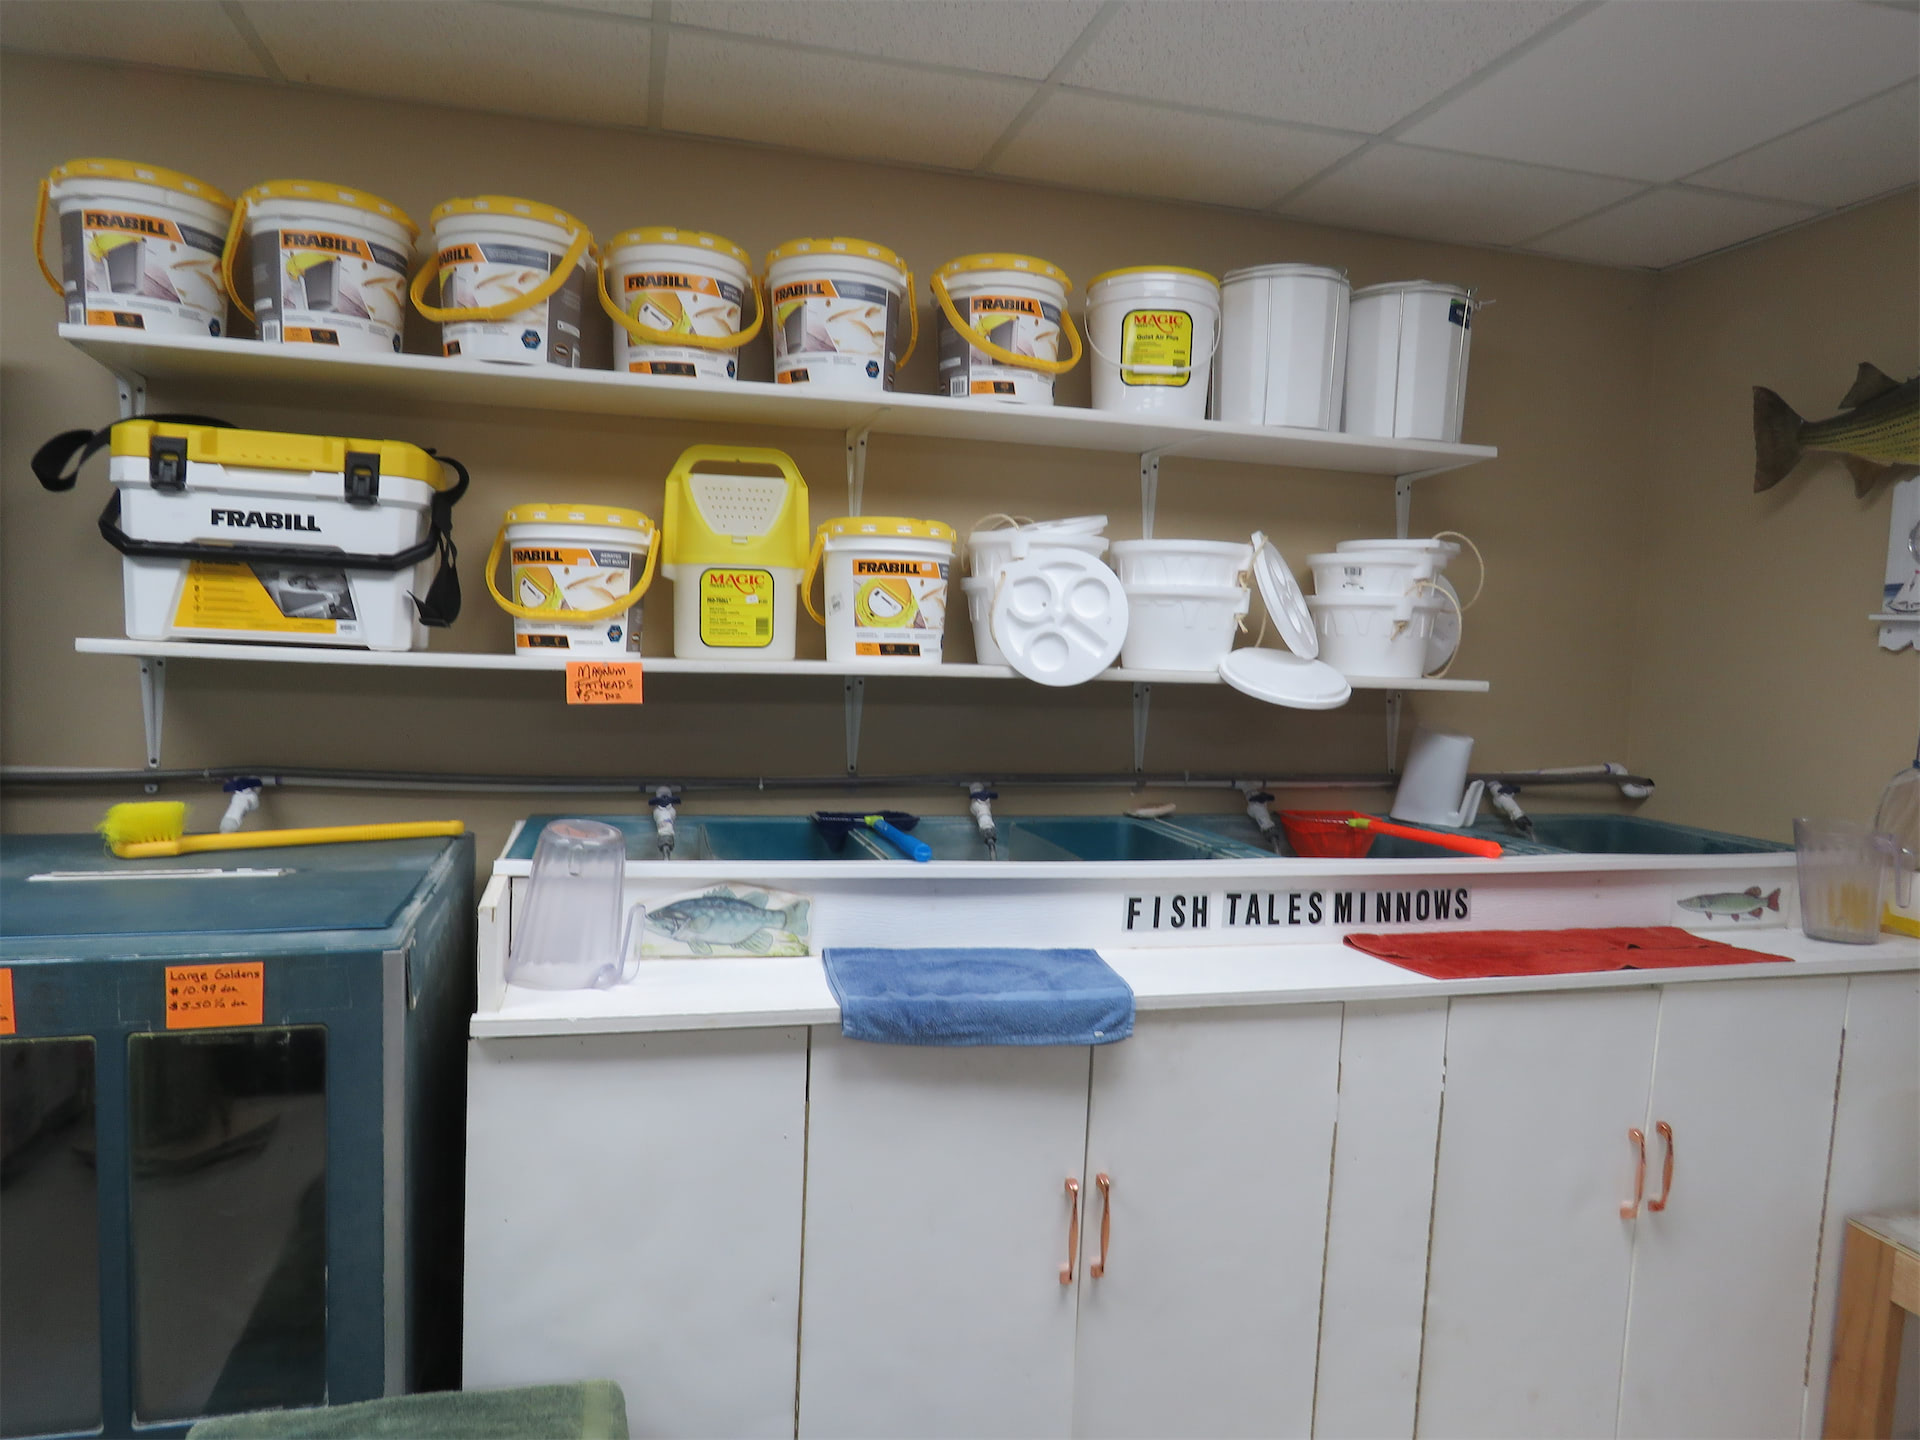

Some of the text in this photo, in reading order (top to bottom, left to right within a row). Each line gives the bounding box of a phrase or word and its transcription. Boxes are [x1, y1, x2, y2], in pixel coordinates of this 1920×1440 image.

[86, 213, 169, 236] FRABILL
[284, 233, 361, 255] FRABILL
[628, 275, 692, 289] FRABILL
[775, 282, 825, 302] FRABILL
[973, 298, 1035, 313] FRABILL
[1134, 314, 1183, 333] MAGIC
[210, 508, 322, 533] FRABILL
[857, 561, 920, 574] FRABILL
[710, 573, 765, 595] MAGIC
[1127, 888, 1469, 930] FISH TALES MINNOWS
